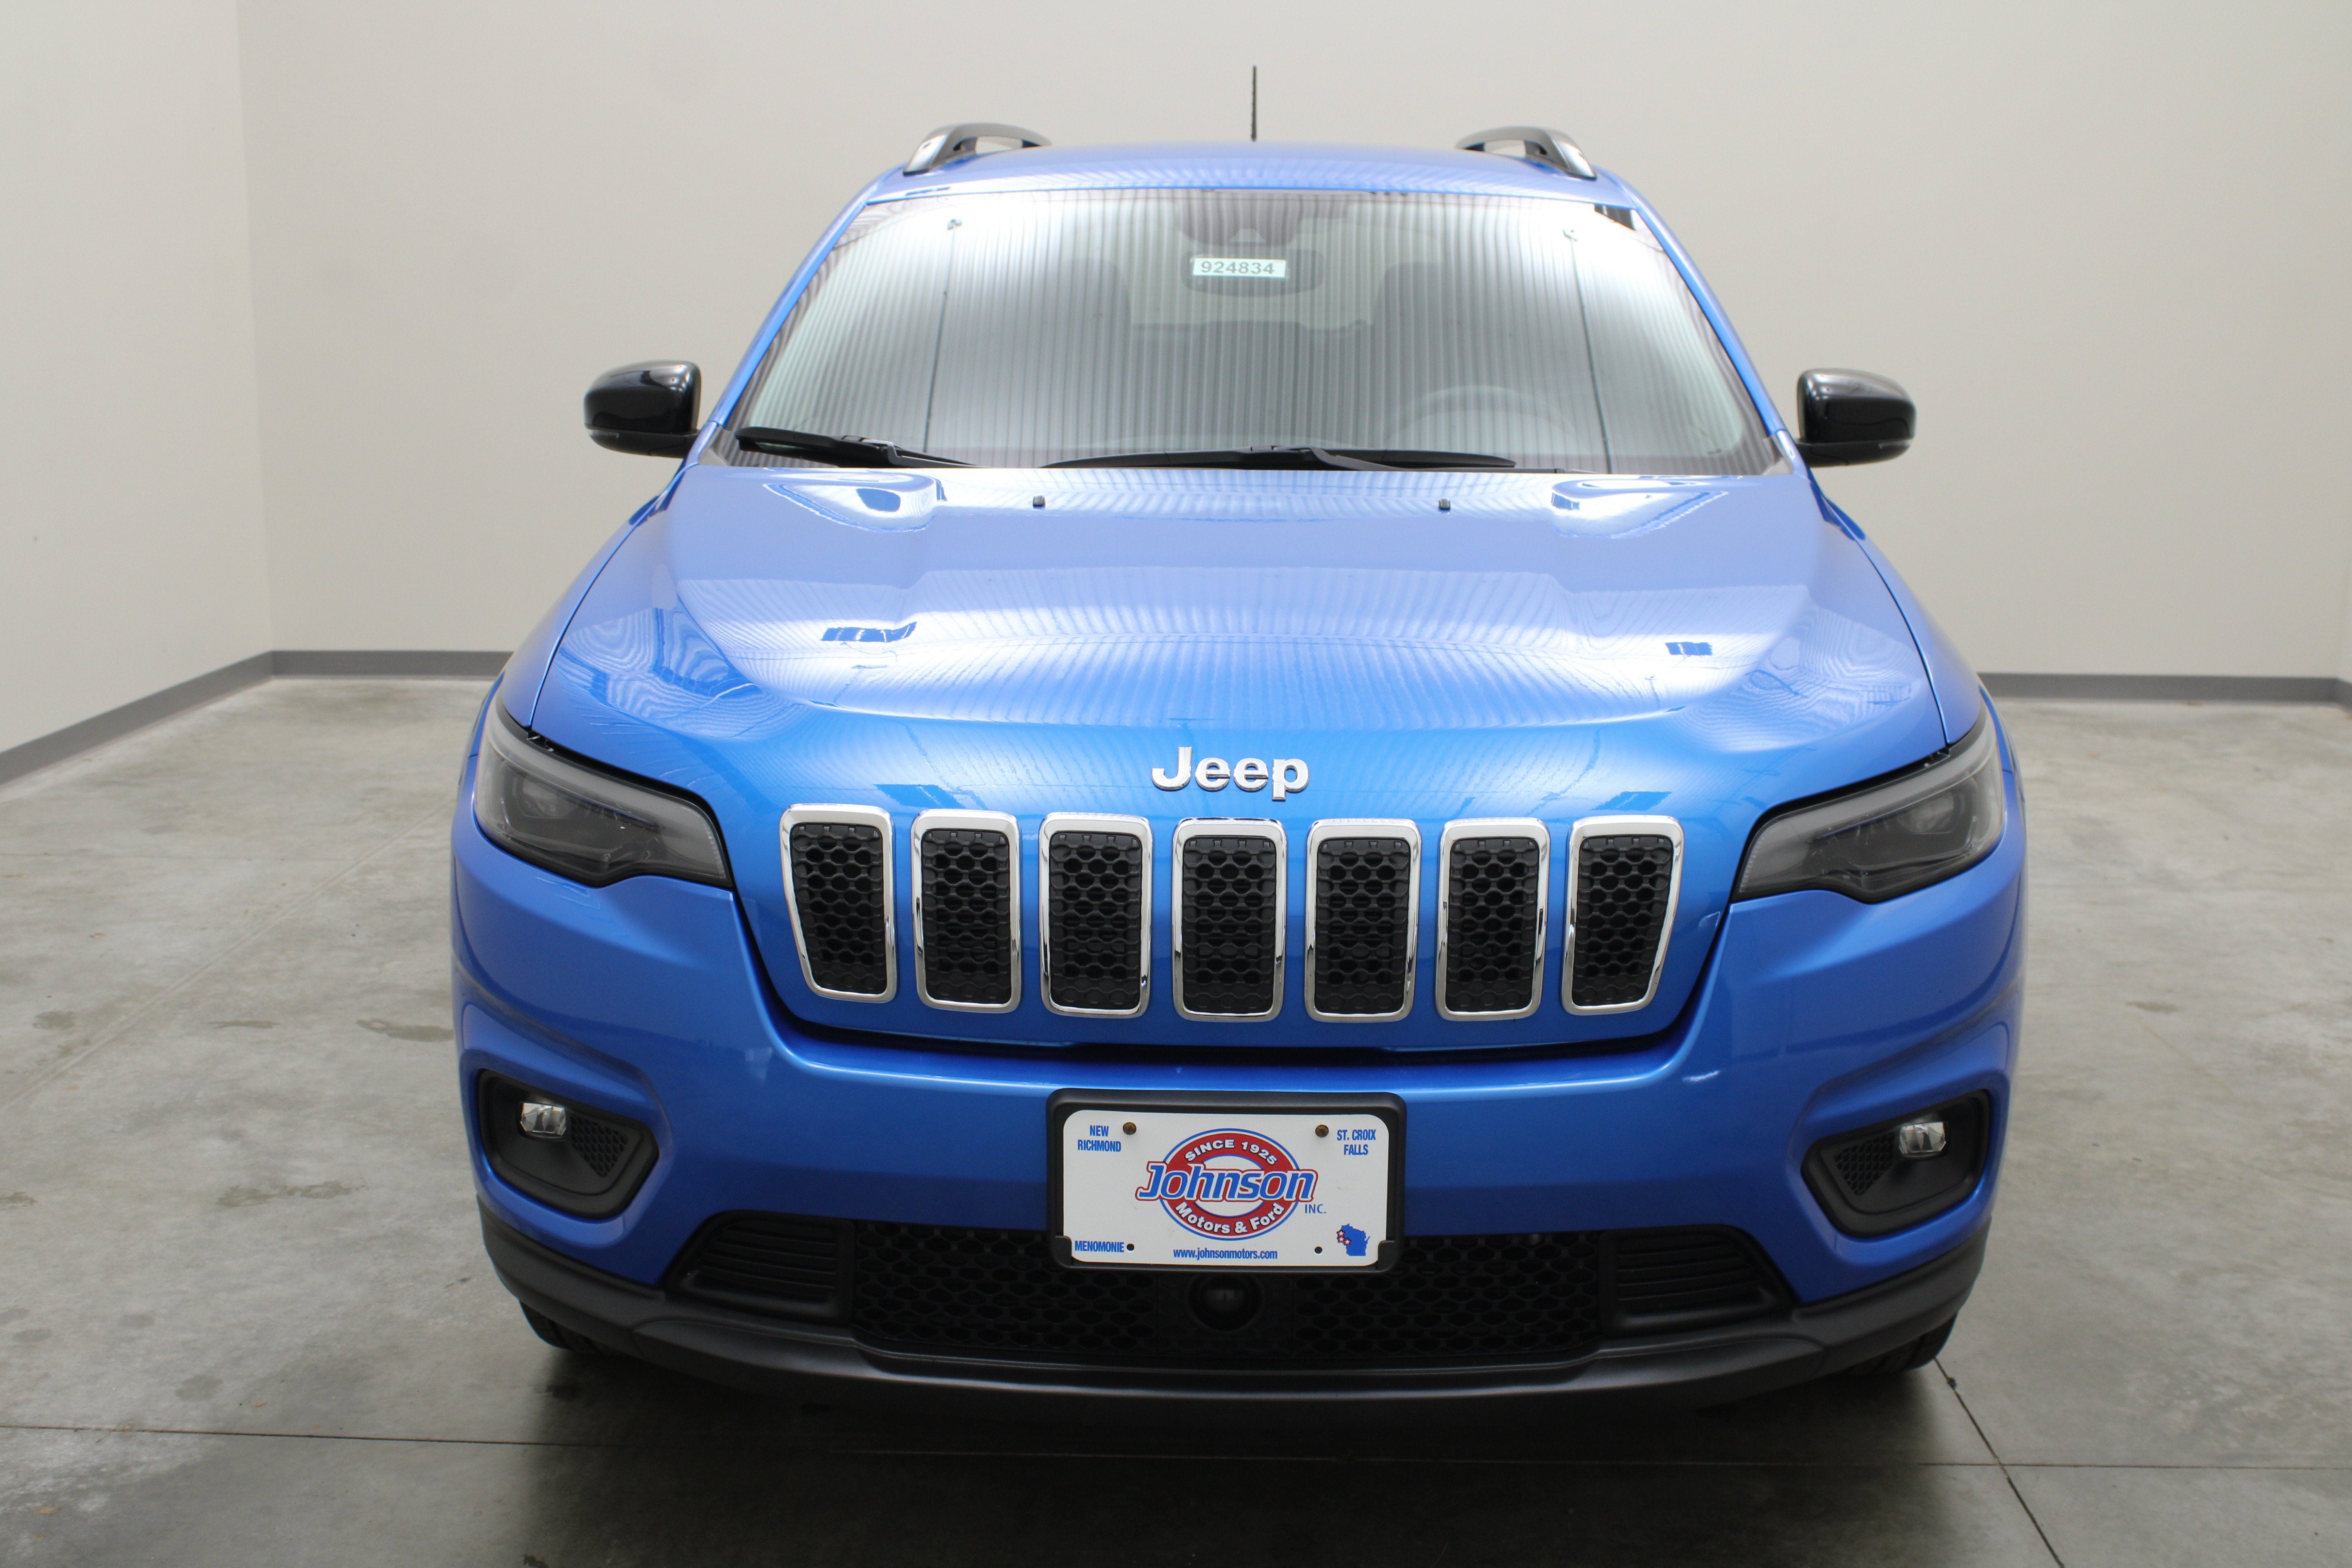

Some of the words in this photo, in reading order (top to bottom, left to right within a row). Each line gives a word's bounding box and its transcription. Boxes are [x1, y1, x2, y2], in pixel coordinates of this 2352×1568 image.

[1201, 261, 1275, 274] 924834
[1152, 746, 1310, 802] Jeep
[1089, 1125, 1109, 1137] NEW
[1336, 1129, 1350, 1140] ST.
[1352, 1129, 1376, 1140] CROIX
[1077, 1139, 1121, 1152] RICHMOND
[1185, 1139, 1235, 1161] SINCE
[1241, 1141, 1278, 1165] 1925
[1343, 1144, 1369, 1156] FALLS
[1137, 1163, 1316, 1200] Johnson
[1304, 1204, 1327, 1214] INC.
[1175, 1201, 1231, 1234] Motors
[1234, 1221, 1248, 1234] &
[1249, 1202, 1285, 1231] Ford
[1074, 1240, 1125, 1253] MENOMONIE
[1173, 1247, 1278, 1261] www.johnsonmotors.com
